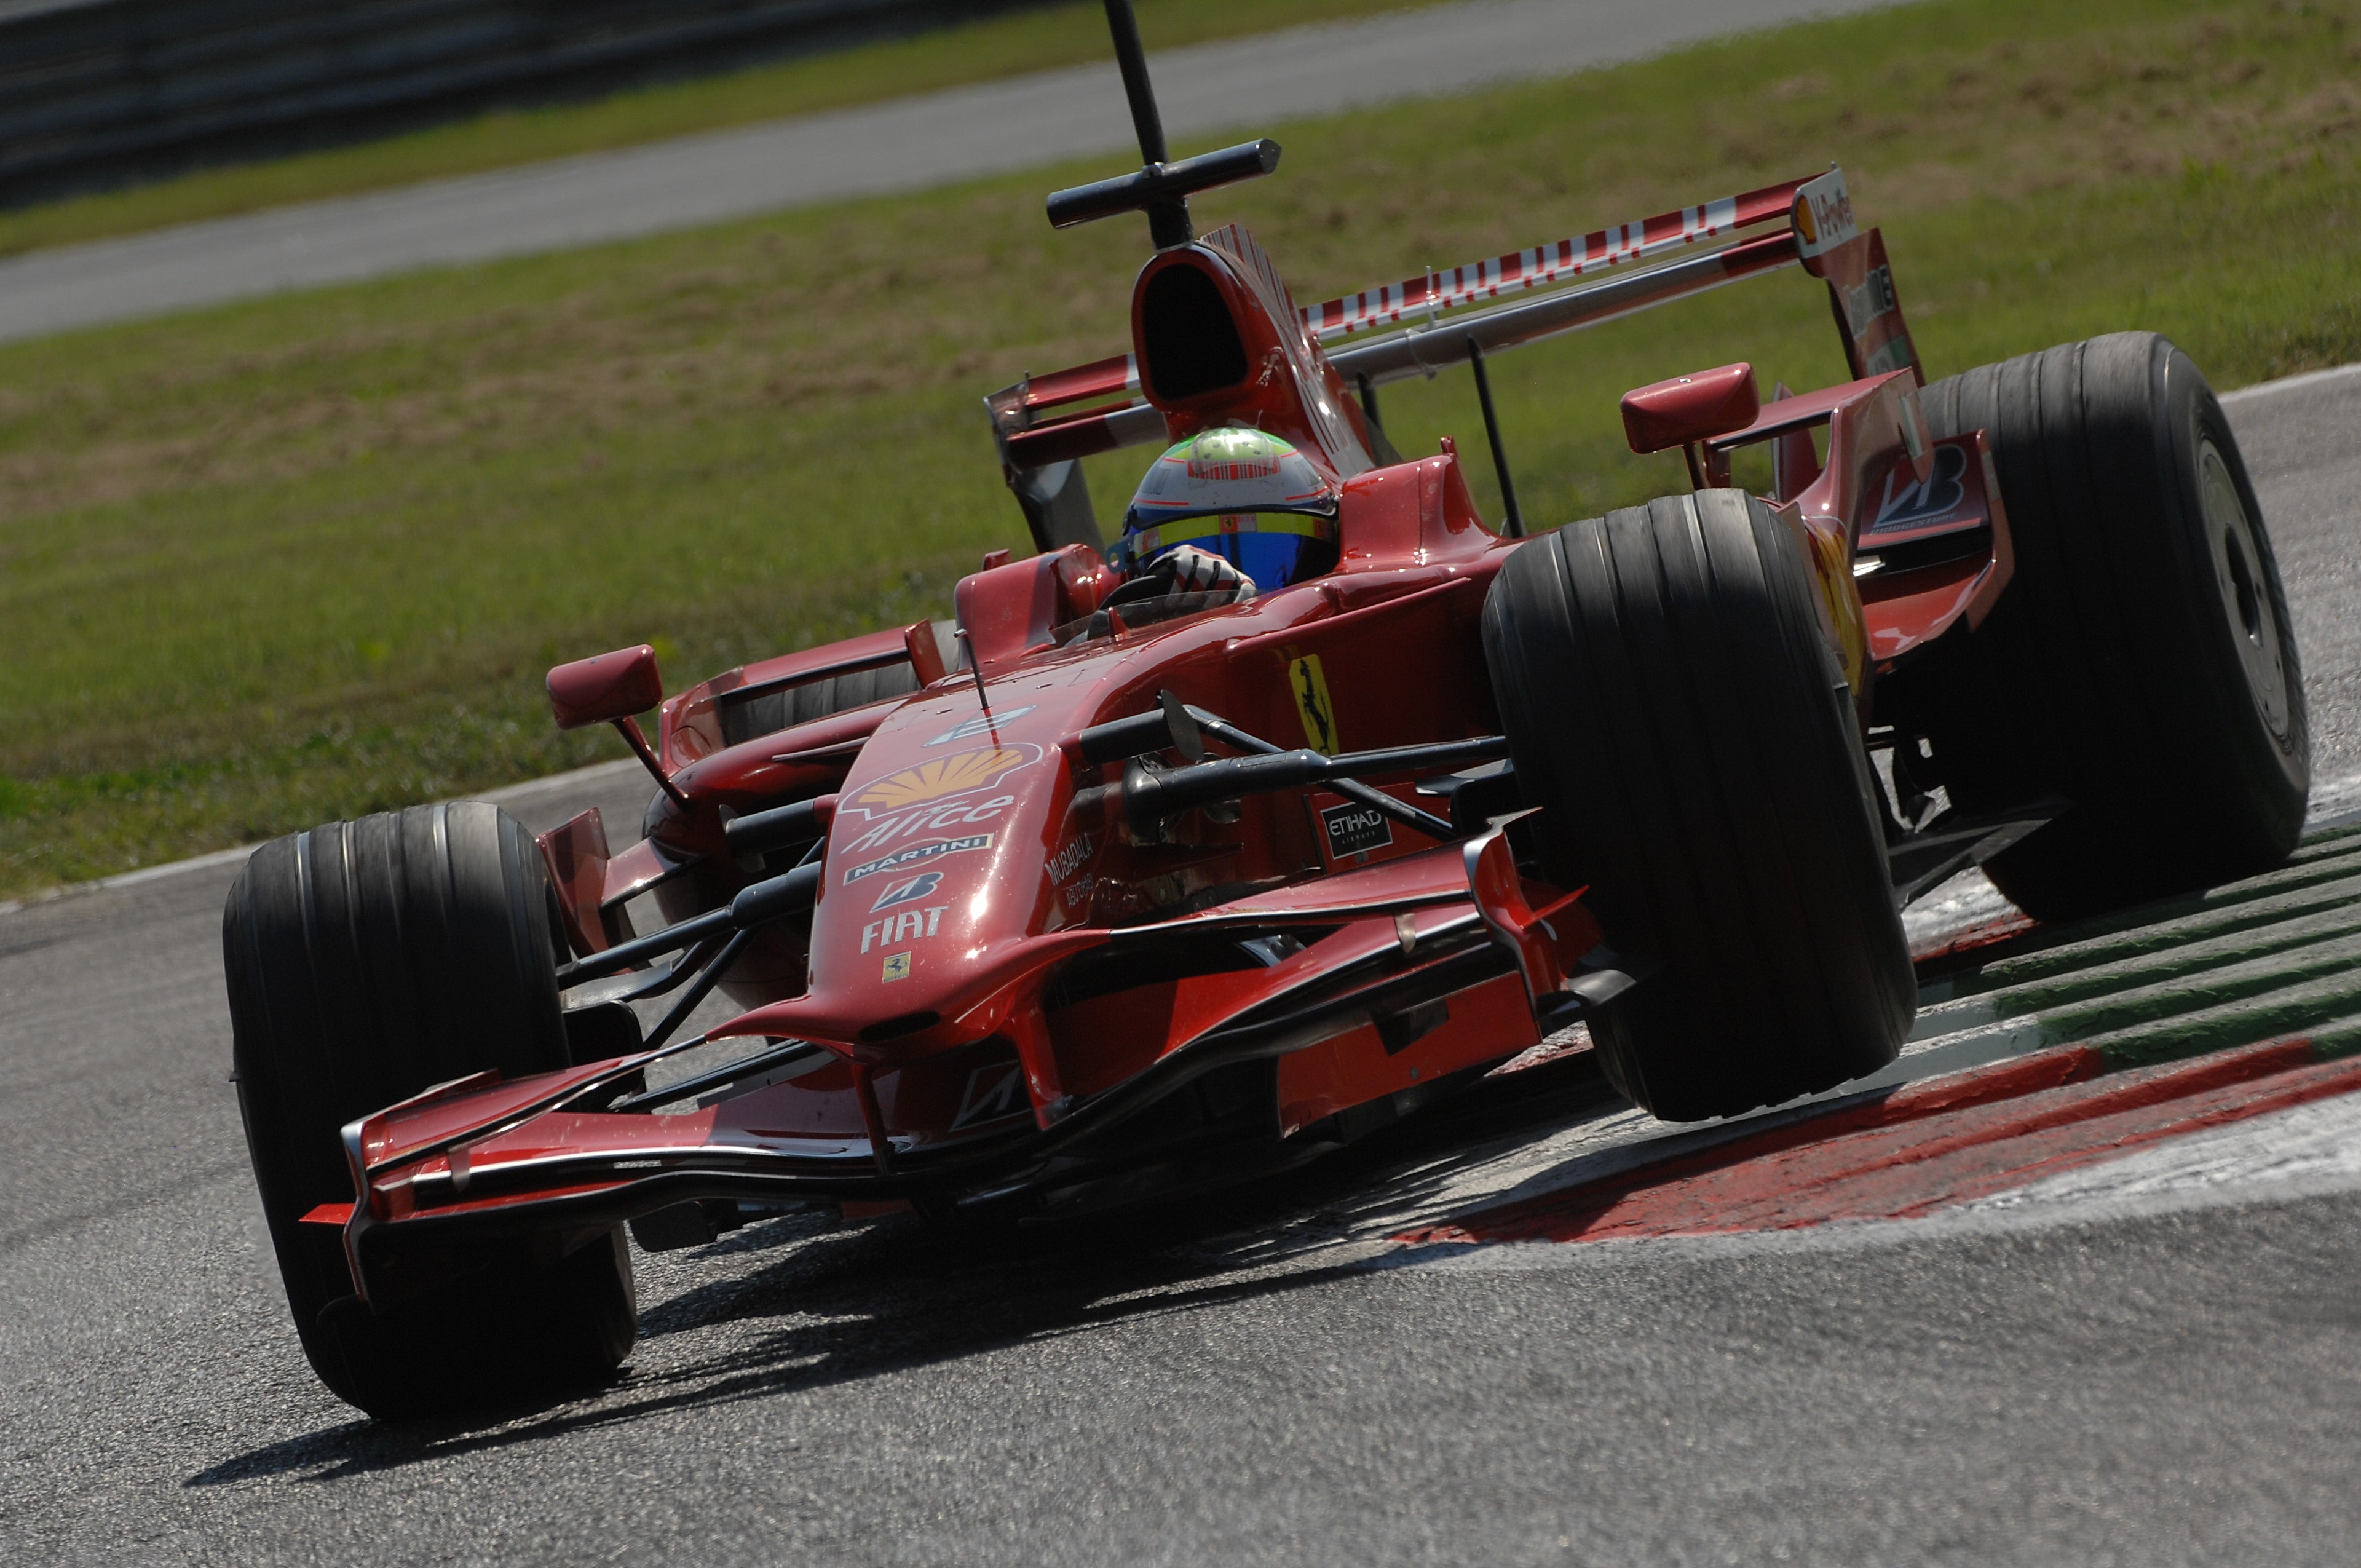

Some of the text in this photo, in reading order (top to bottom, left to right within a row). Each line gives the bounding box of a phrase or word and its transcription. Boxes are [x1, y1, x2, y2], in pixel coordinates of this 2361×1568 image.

[840, 795, 1014, 855] Alice
[1329, 810, 1382, 836] ETIHAD
[854, 838, 981, 878] MARTINI
[1044, 831, 1094, 886] MUBADALA
[861, 906, 950, 954] FIAT
